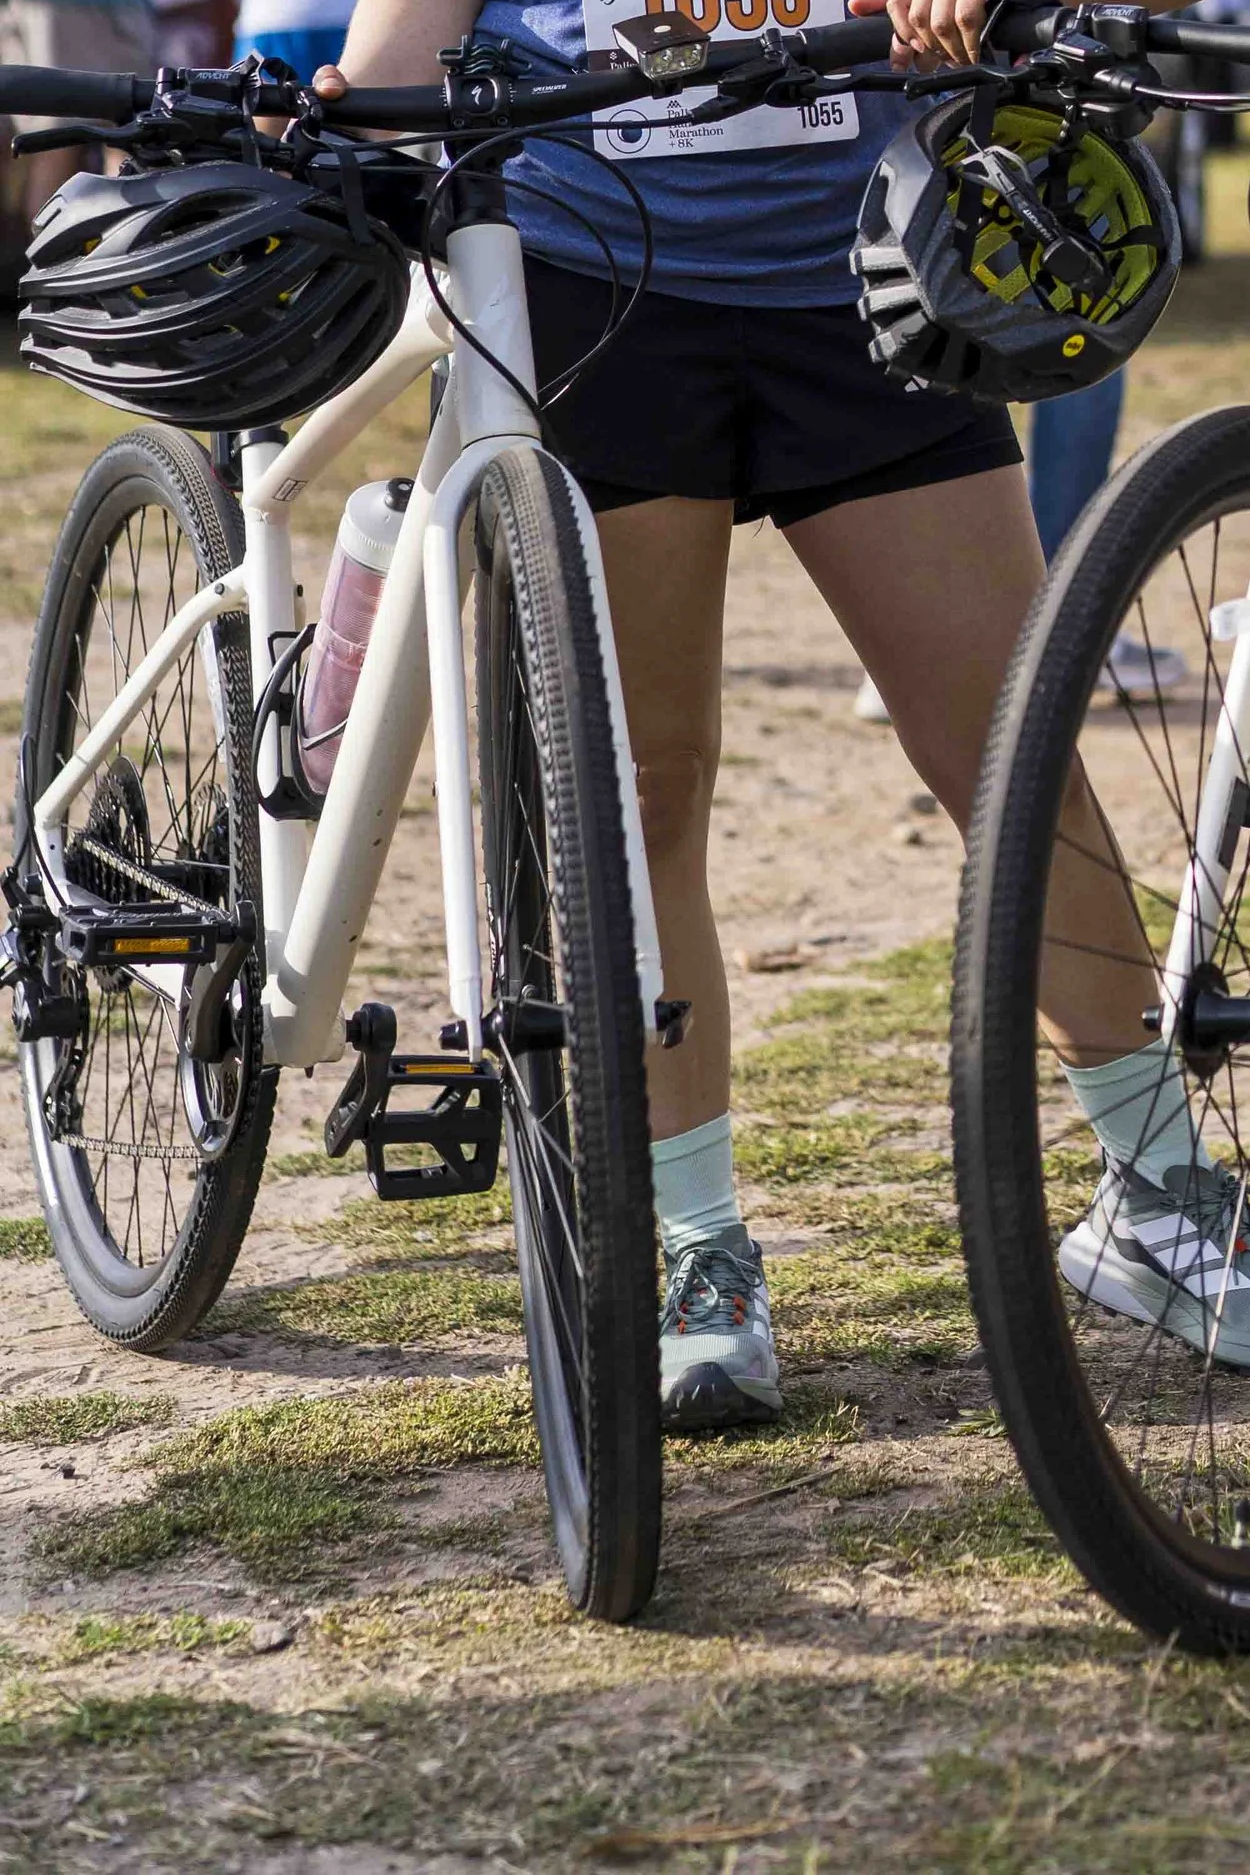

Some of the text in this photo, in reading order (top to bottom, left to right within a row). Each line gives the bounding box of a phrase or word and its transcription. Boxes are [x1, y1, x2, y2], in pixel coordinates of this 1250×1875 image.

[195, 71, 232, 80] ADVENT
[797, 100, 844, 129] 1055
[669, 127, 724, 139] Marathon
